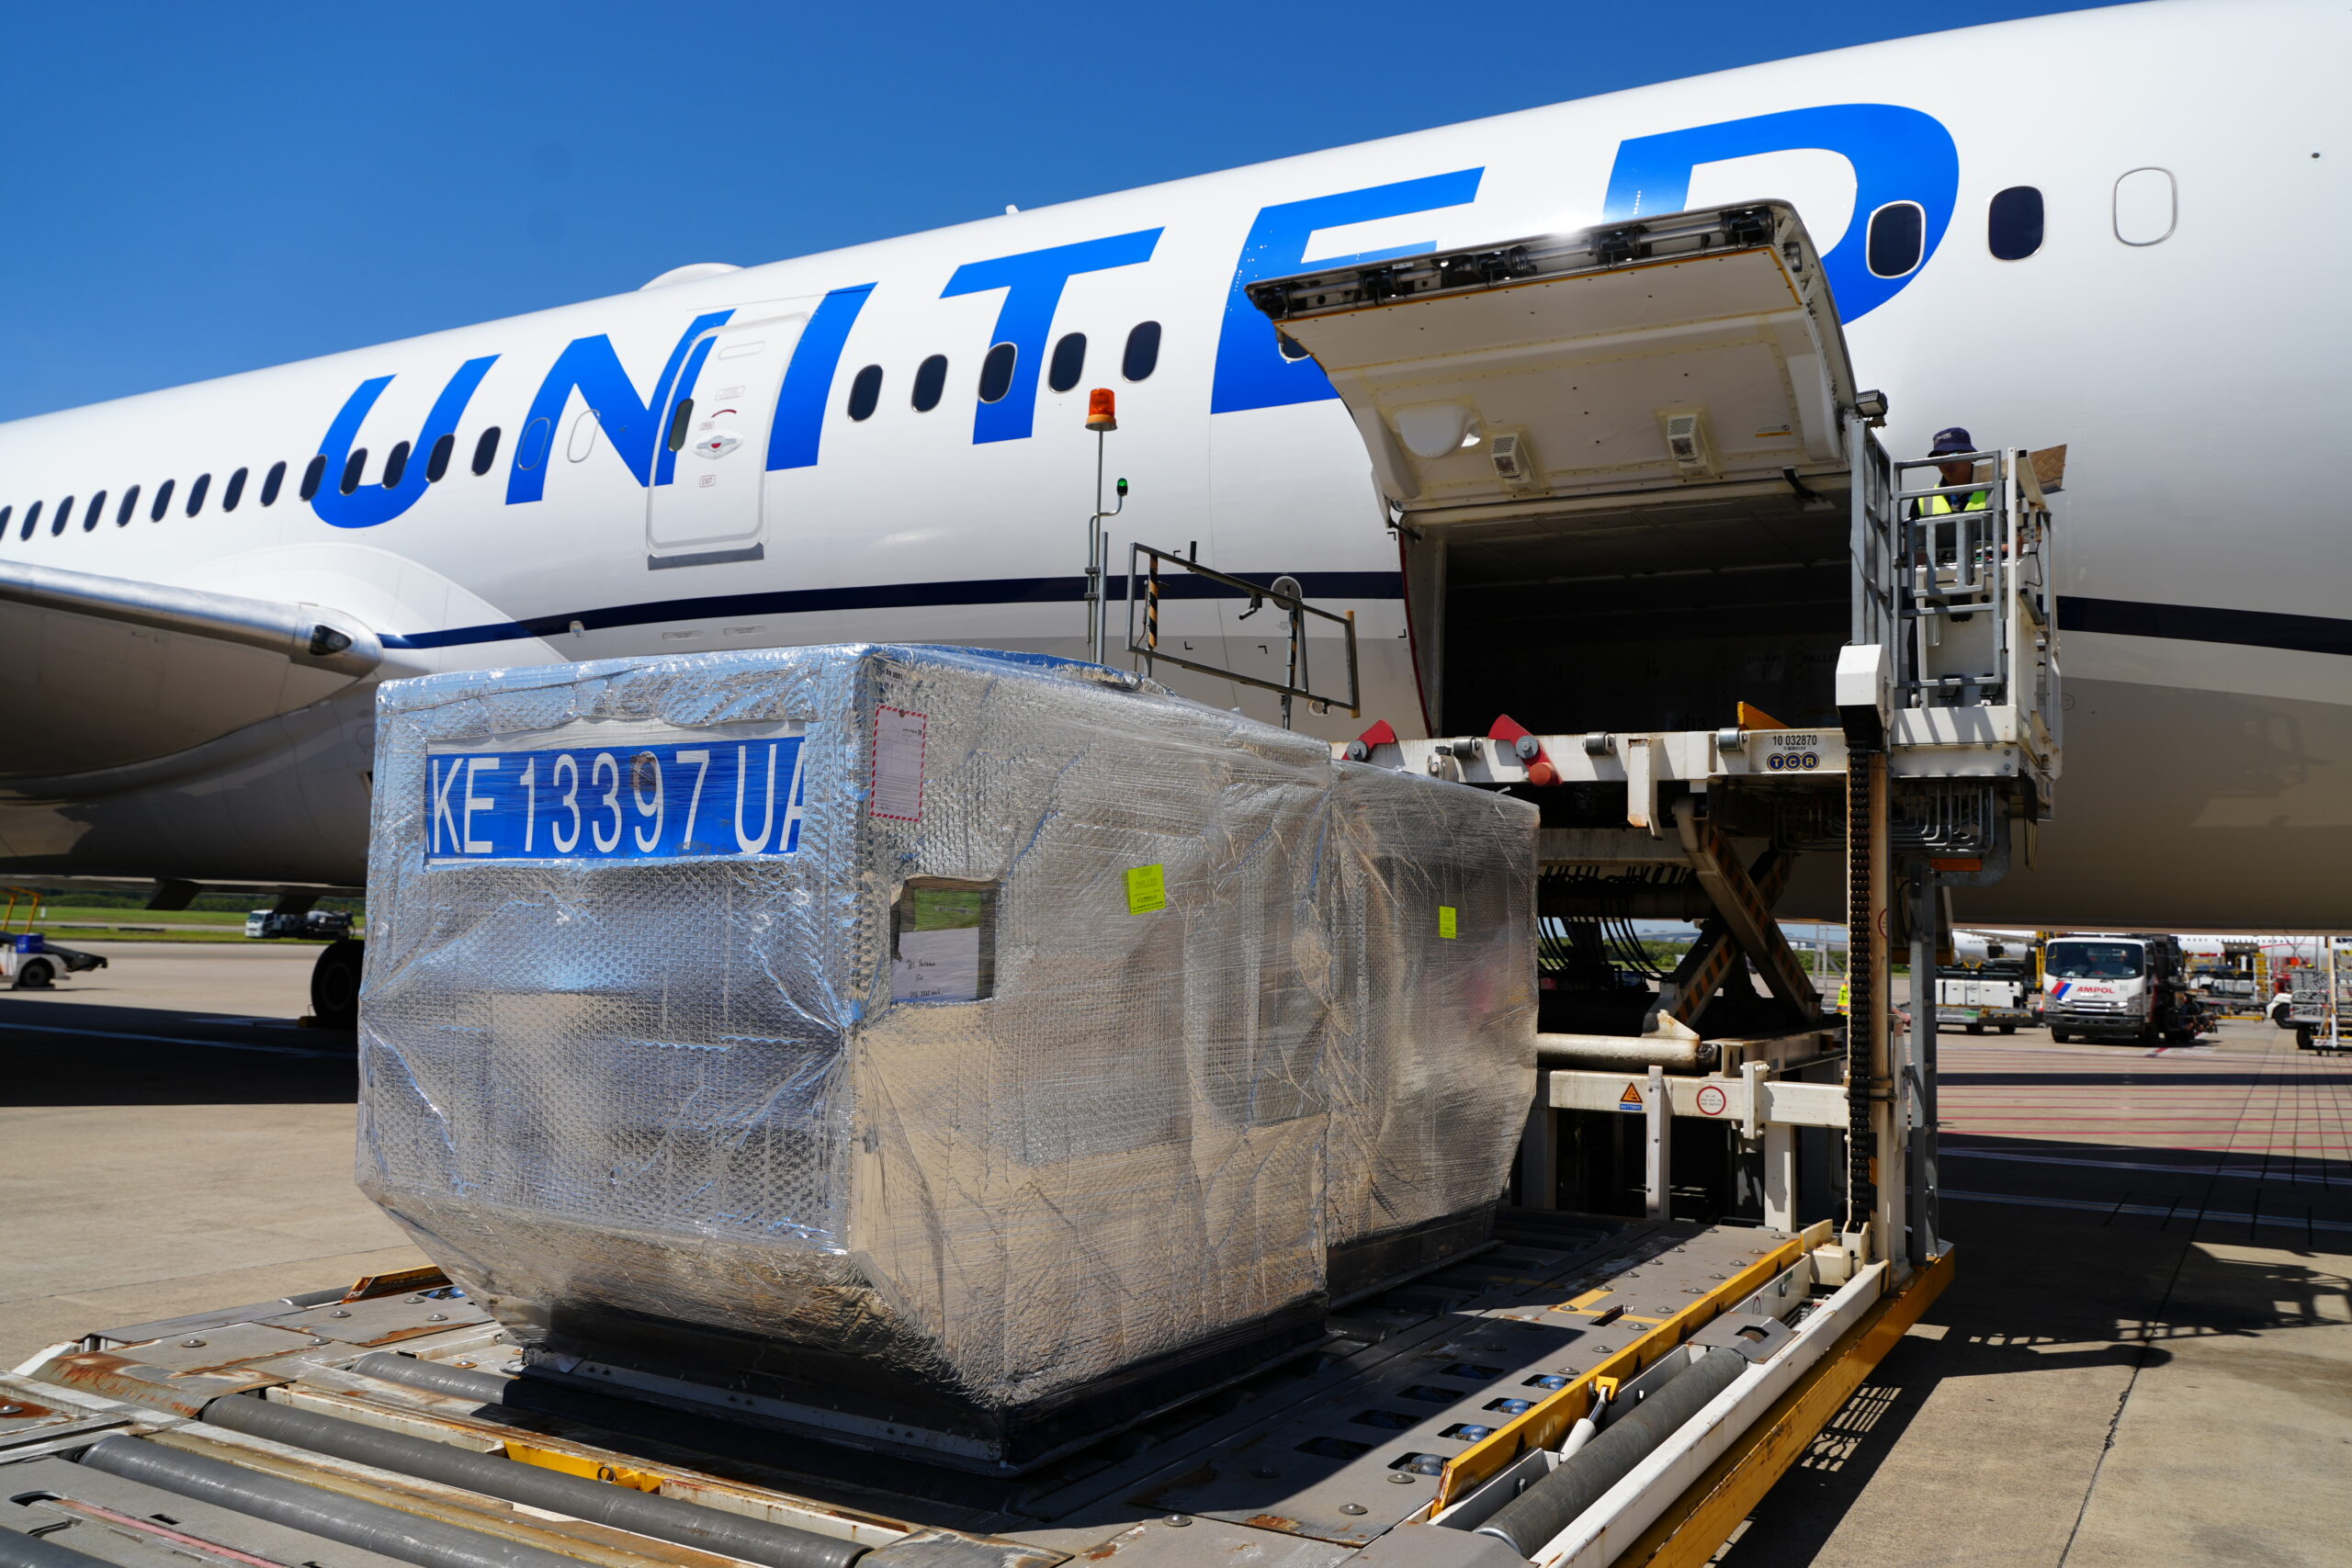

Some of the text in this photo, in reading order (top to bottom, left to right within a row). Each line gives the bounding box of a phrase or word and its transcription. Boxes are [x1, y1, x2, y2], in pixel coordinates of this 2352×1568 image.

[310, 103, 1960, 529] UNITED
[1772, 734, 1817, 746] 10 032870
[1771, 756, 1815, 768] TCR
[426, 757, 501, 854] KE
[519, 750, 710, 854] 13397
[2076, 986, 2115, 994] AMPOL
